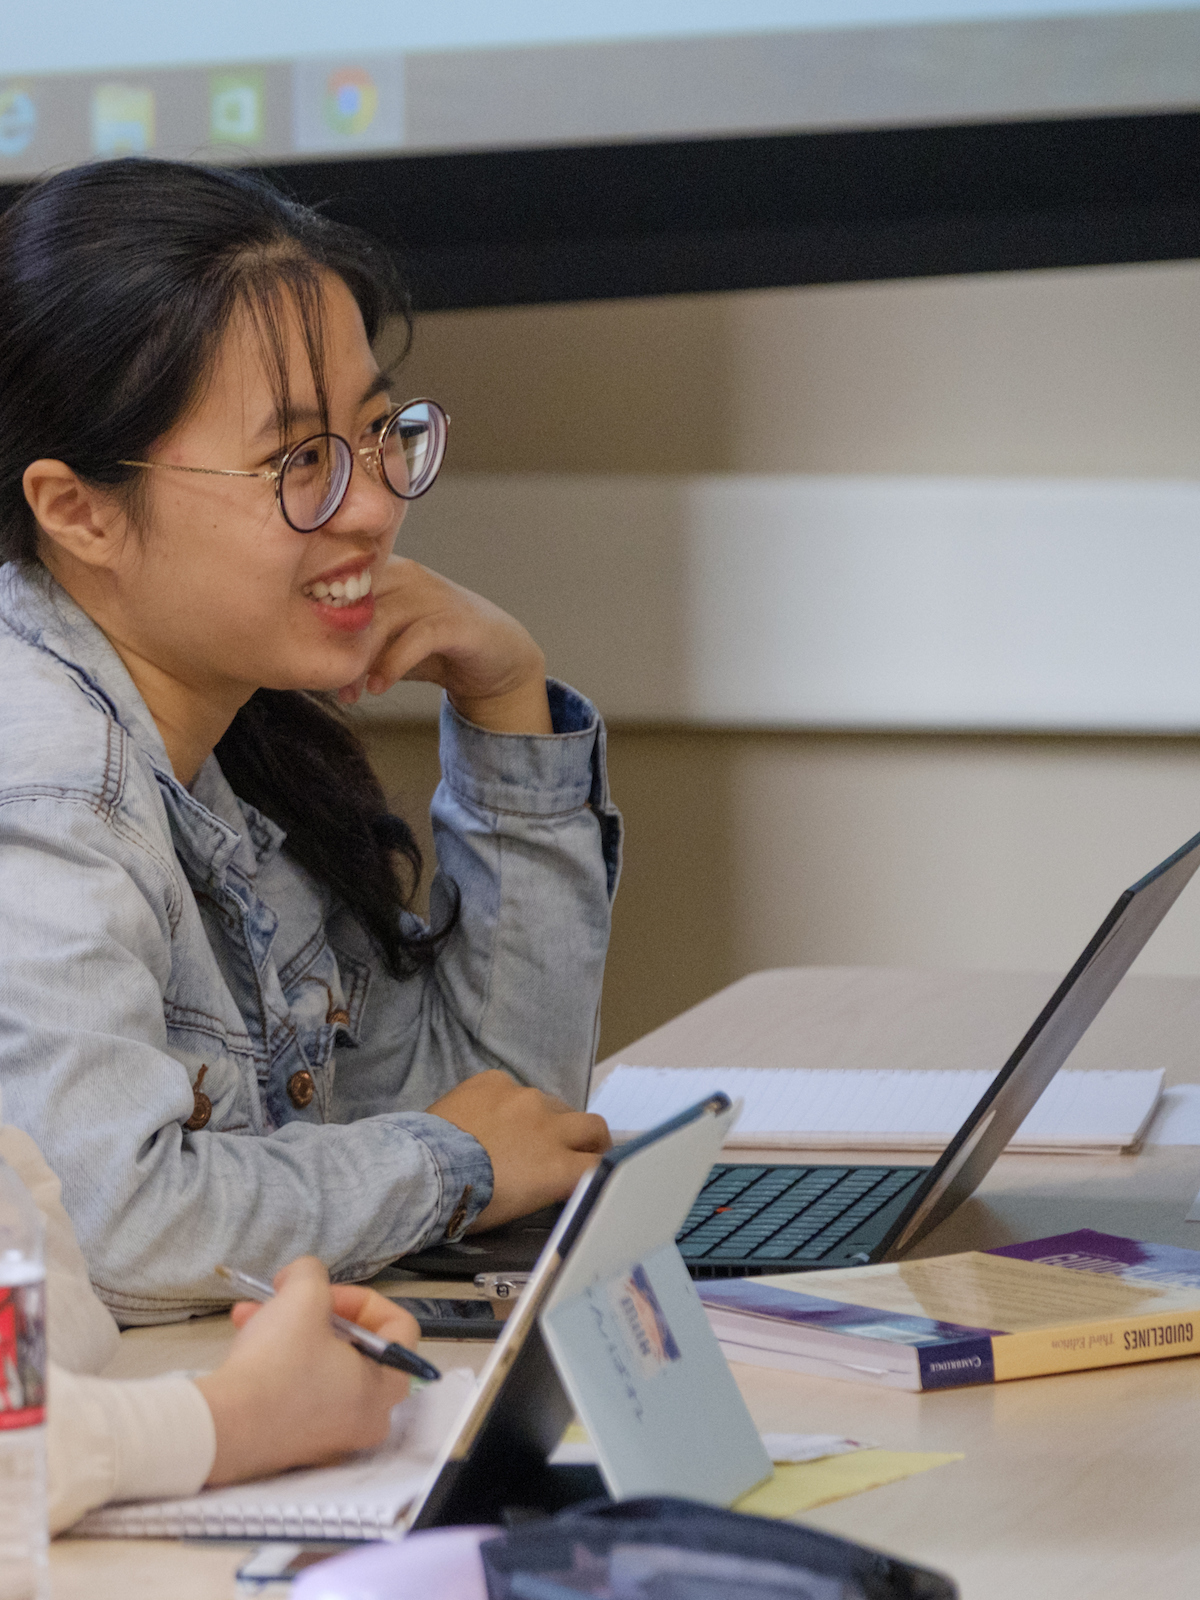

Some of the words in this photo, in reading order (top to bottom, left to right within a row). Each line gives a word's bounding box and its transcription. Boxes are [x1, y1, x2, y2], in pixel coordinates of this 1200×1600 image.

[1051, 1336, 1086, 1352] Edition
[1089, 1332, 1115, 1348] Third
[1123, 1322, 1194, 1350] GUIDELINES
[930, 1355, 982, 1373] CAMBRIDGE
